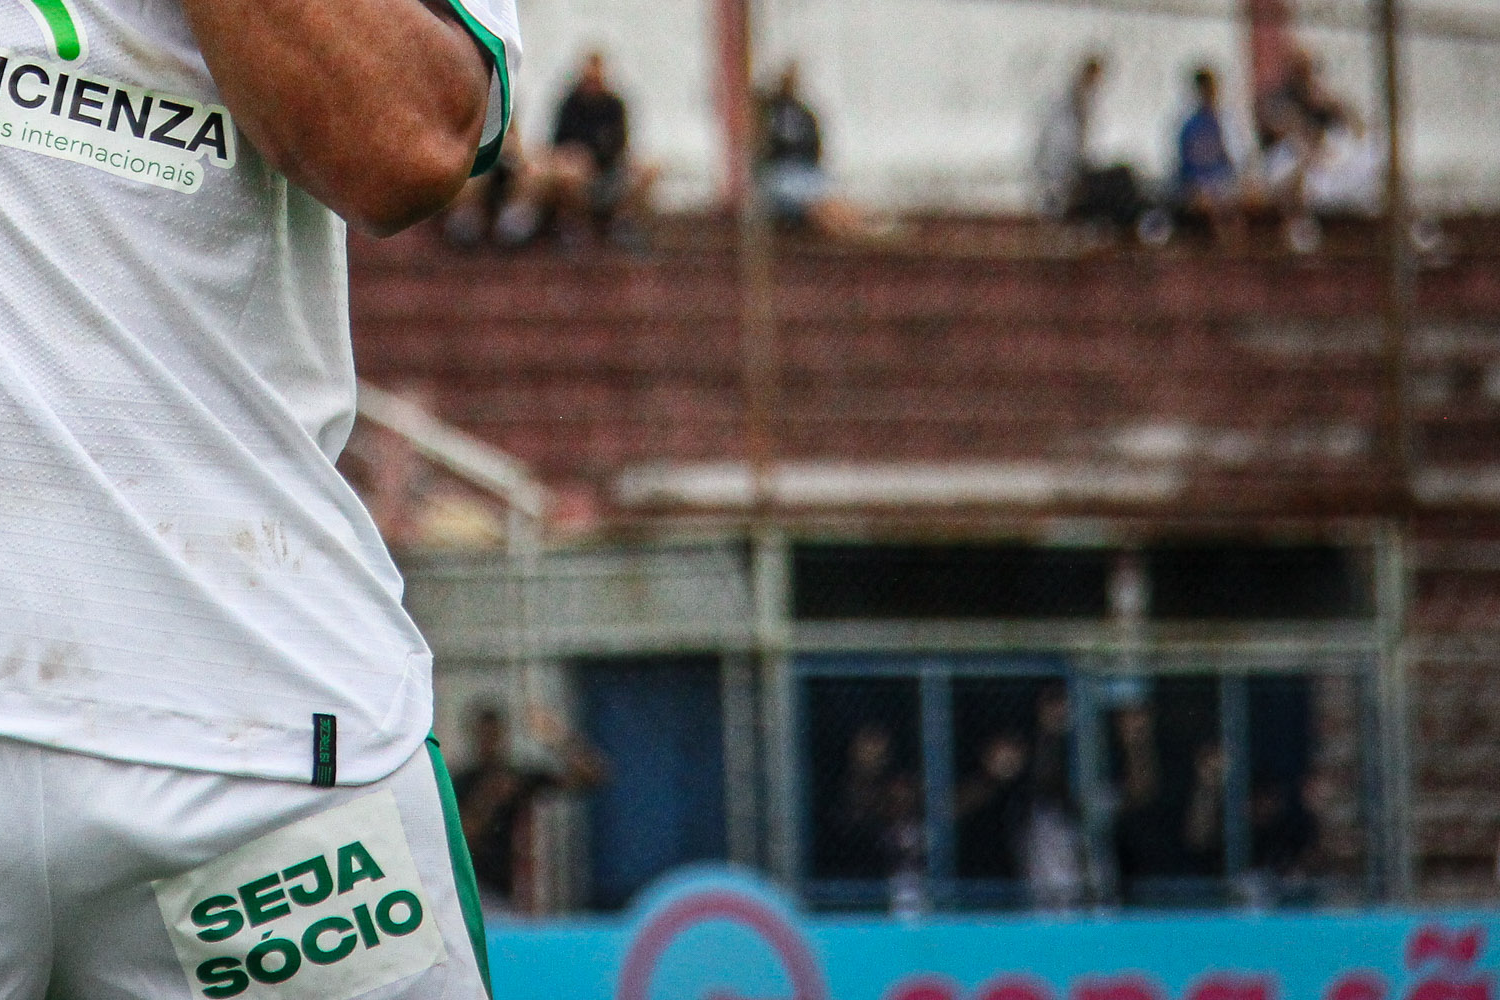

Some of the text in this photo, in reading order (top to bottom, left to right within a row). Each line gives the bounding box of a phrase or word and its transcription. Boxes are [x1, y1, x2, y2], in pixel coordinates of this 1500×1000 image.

[21, 122, 196, 187] internacionais
[191, 840, 386, 943] SEJA
[195, 889, 424, 1000] SÓCIO
